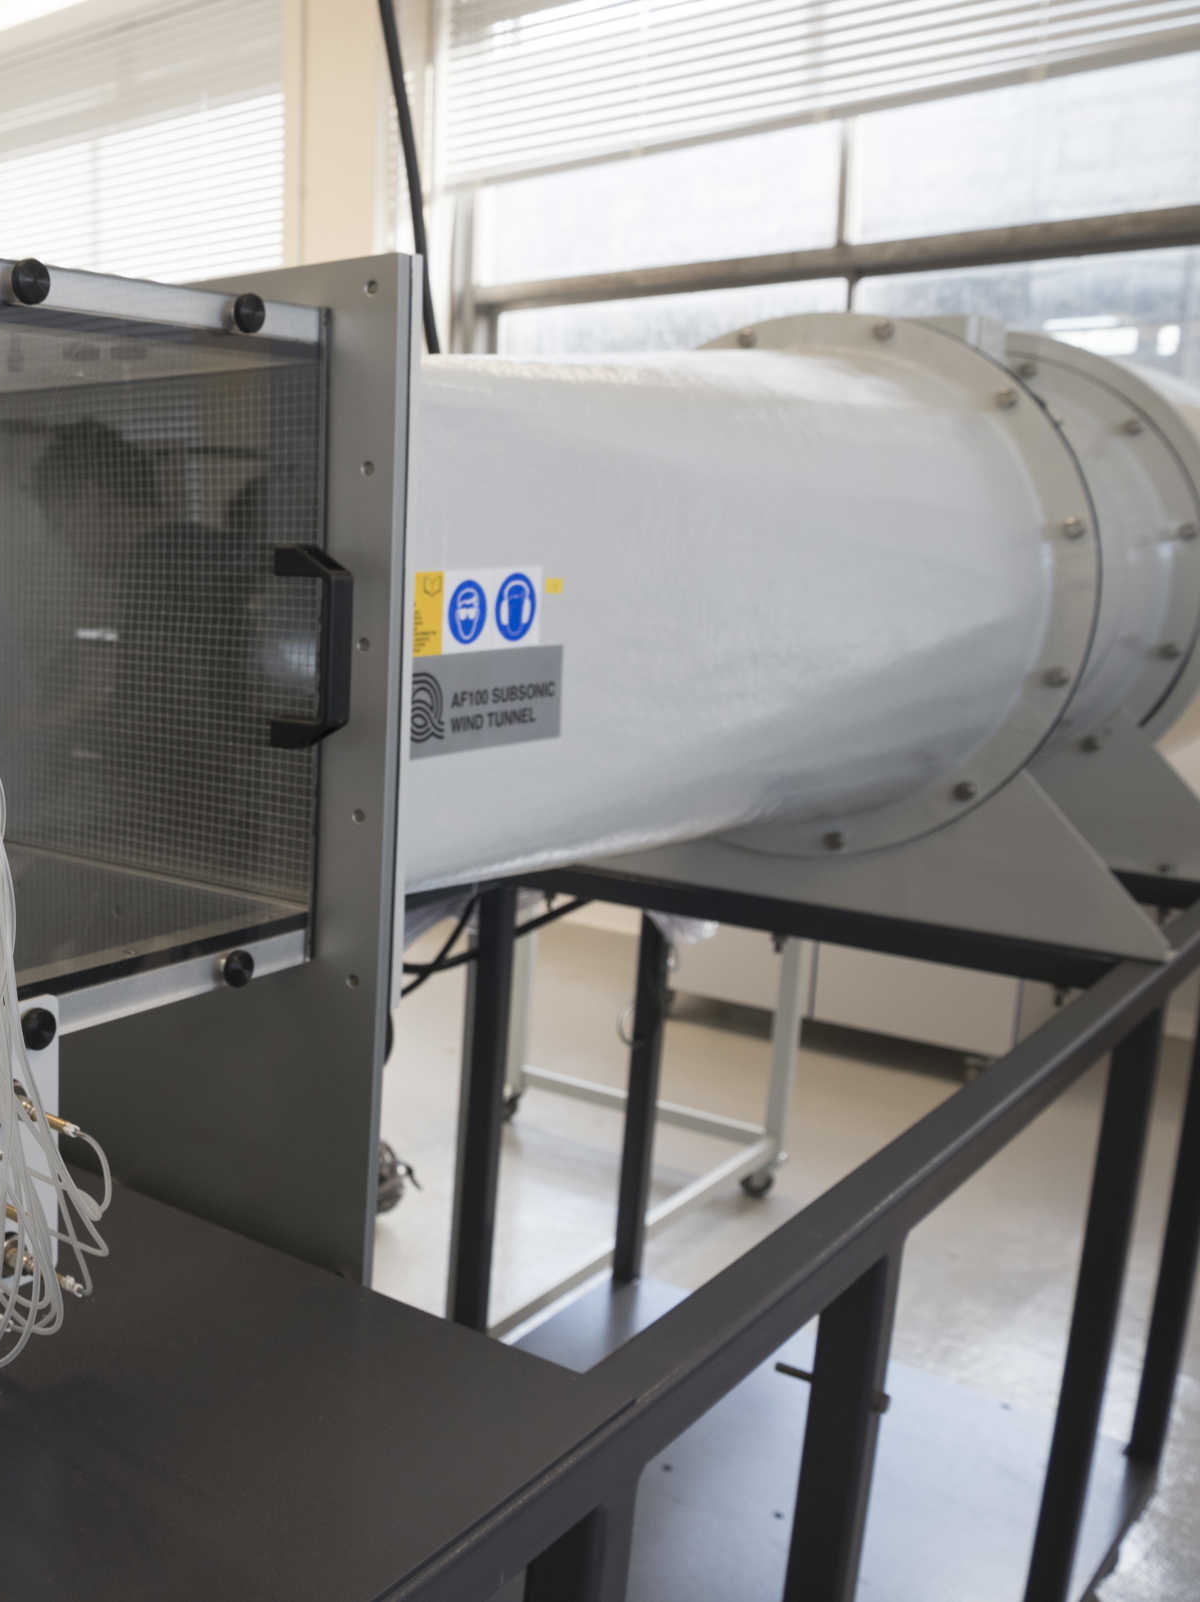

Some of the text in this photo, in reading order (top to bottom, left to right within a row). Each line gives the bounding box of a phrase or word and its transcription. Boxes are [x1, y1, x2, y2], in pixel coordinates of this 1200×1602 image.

[450, 681, 556, 709] AF100 SUBSONIC
[450, 707, 537, 734] WIND TUNNEL
